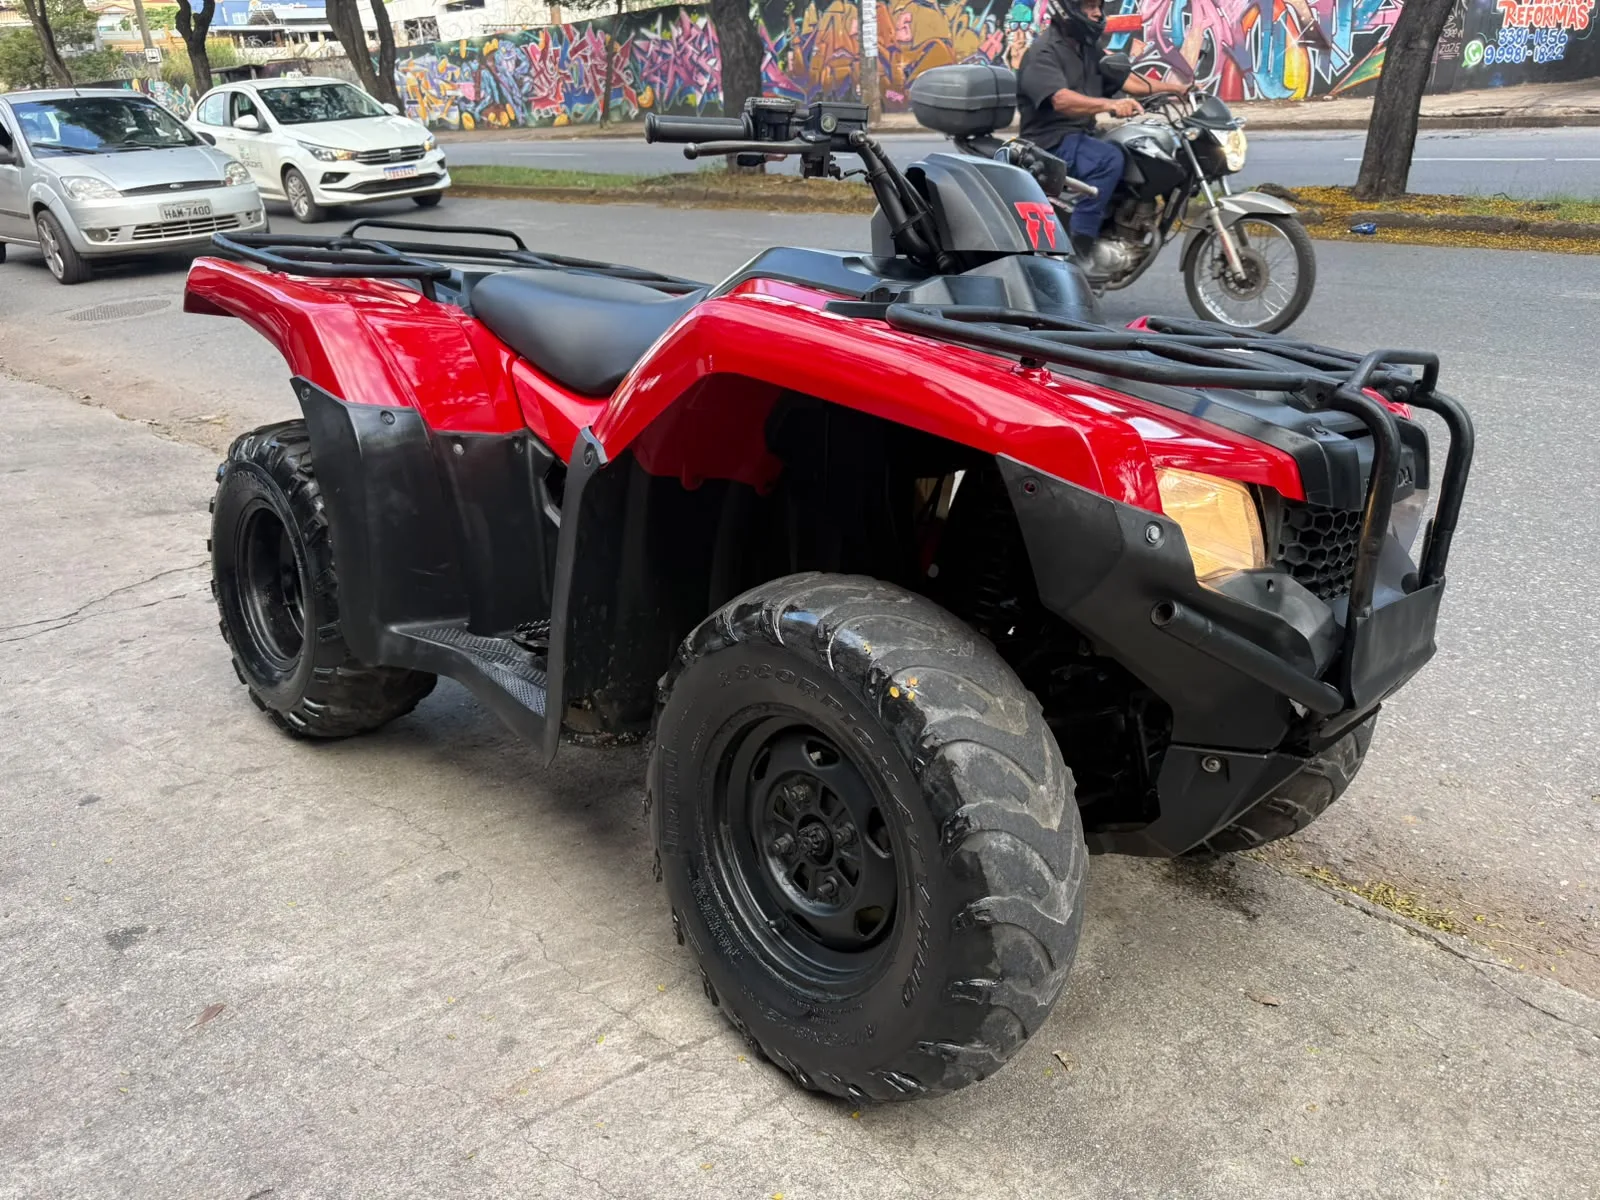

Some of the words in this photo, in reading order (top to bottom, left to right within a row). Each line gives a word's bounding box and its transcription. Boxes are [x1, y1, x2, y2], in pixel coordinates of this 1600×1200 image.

[1497, 0, 1590, 31] REFORMAS
[1498, 27, 1568, 46] 3381-1656
[163, 205, 211, 220] HAM-7400
